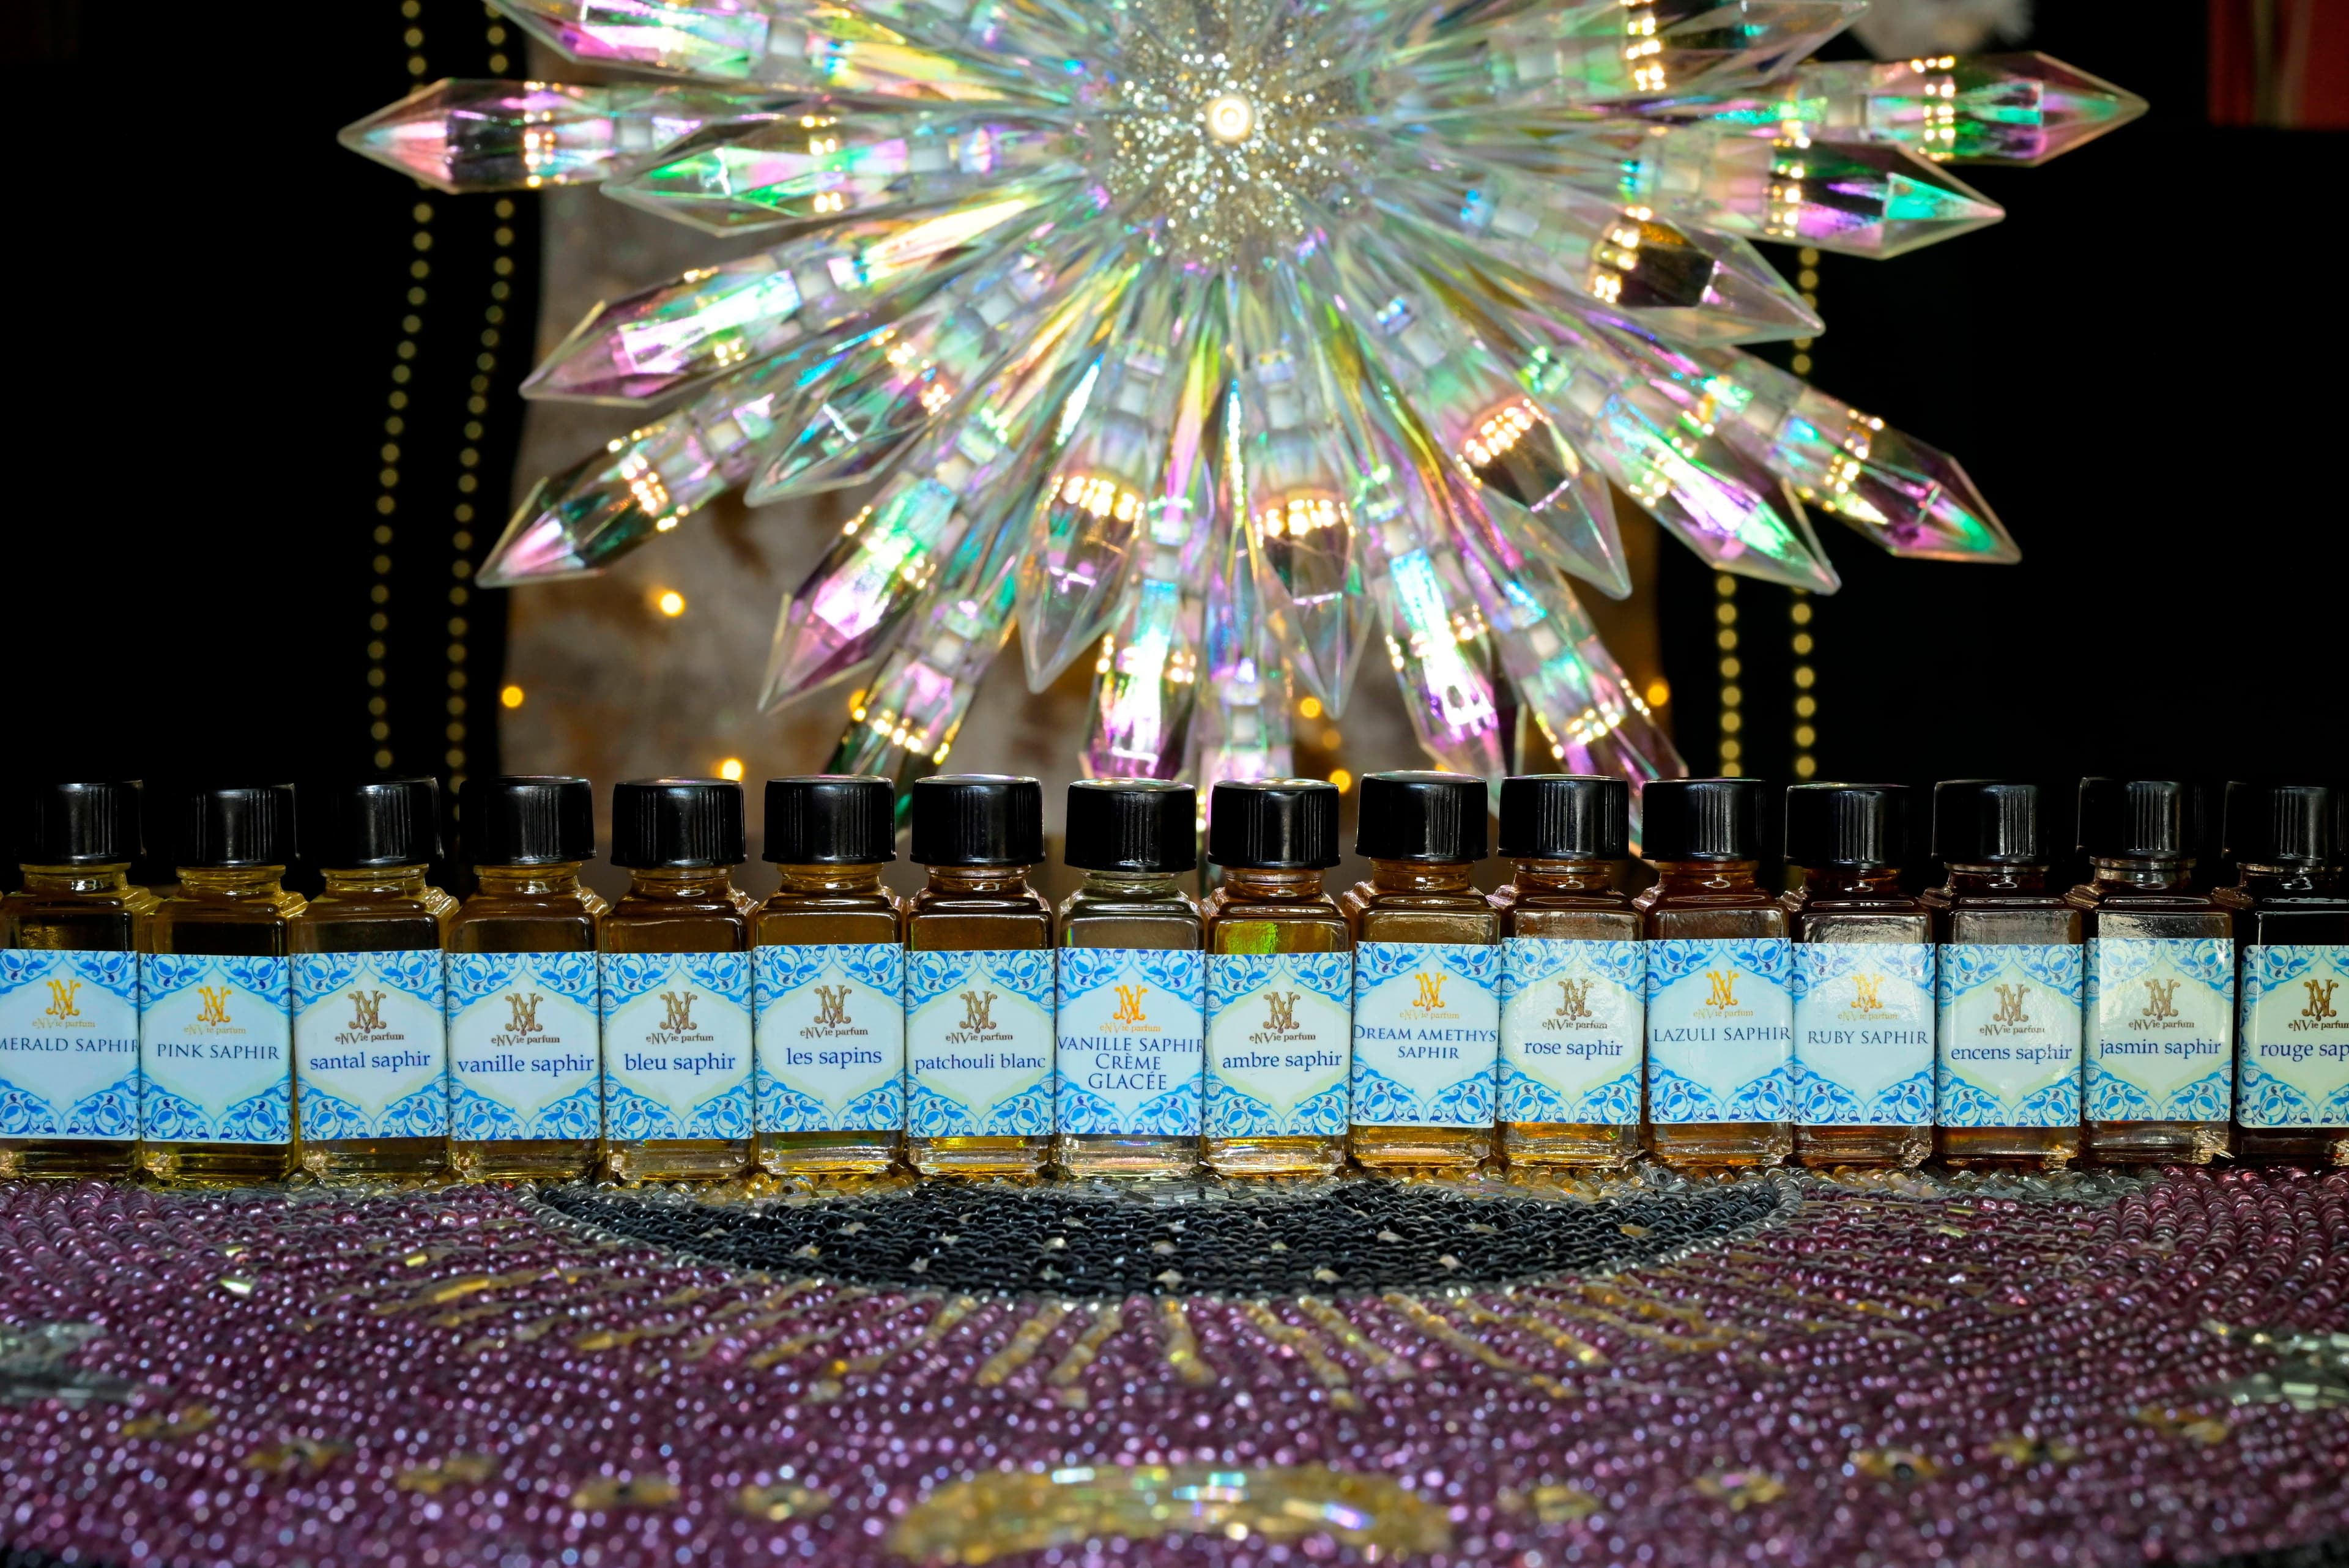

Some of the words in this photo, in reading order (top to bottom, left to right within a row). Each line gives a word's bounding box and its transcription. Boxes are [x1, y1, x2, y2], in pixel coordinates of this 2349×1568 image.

[1724, 1009, 1754, 1017] parfum
[835, 1027, 869, 1037] parfum
[1576, 1020, 1608, 1030] parfum
[2013, 1025, 2045, 1035] parfum
[2162, 1020, 2195, 1029] parfum
[371, 1033, 404, 1042] parfum
[527, 1036, 560, 1044] parfum
[681, 1034, 714, 1042] parfum
[980, 1033, 1013, 1042] parfum
[1284, 1033, 1316, 1042] parfum
[1354, 1025, 1412, 1041] DREAM
[1417, 1028, 1497, 1042] AMETHYS
[1653, 1028, 1715, 1042] LAZULI
[1724, 1027, 1792, 1041] SAPHIR
[1808, 1030, 1855, 1044] RUBY
[1861, 1030, 1929, 1044] SAPHIR
[157, 1043, 204, 1058] PINK
[210, 1044, 280, 1060] SAPHIR
[1058, 1036, 1132, 1051] VANILLE
[1140, 1038, 1203, 1053] SAPHIR
[1398, 1046, 1460, 1059] SAPHIR
[1524, 1041, 1562, 1055] rose
[1567, 1039, 1624, 1060] saphir
[2099, 1039, 2159, 1060] jasmin
[2164, 1038, 2221, 1059] saphir
[2260, 1044, 2314, 1062] rouge
[310, 1052, 365, 1070] santal
[371, 1050, 431, 1072] saphir
[787, 1047, 813, 1065] les
[818, 1047, 882, 1069] sapins
[1096, 1053, 1161, 1071] CRÈME
[1223, 1052, 1280, 1069] ambre
[1285, 1051, 1342, 1072] saphir
[1951, 1045, 2011, 1060] encens
[2016, 1044, 2073, 1065] saphir
[458, 1055, 525, 1073] vanille
[531, 1055, 594, 1077] saphir
[624, 1053, 667, 1071] bleu
[673, 1052, 735, 1075] saphir
[915, 1054, 995, 1075] patchouli
[1001, 1053, 1045, 1069] blanc
[1088, 1071, 1167, 1090] GLACÉE
